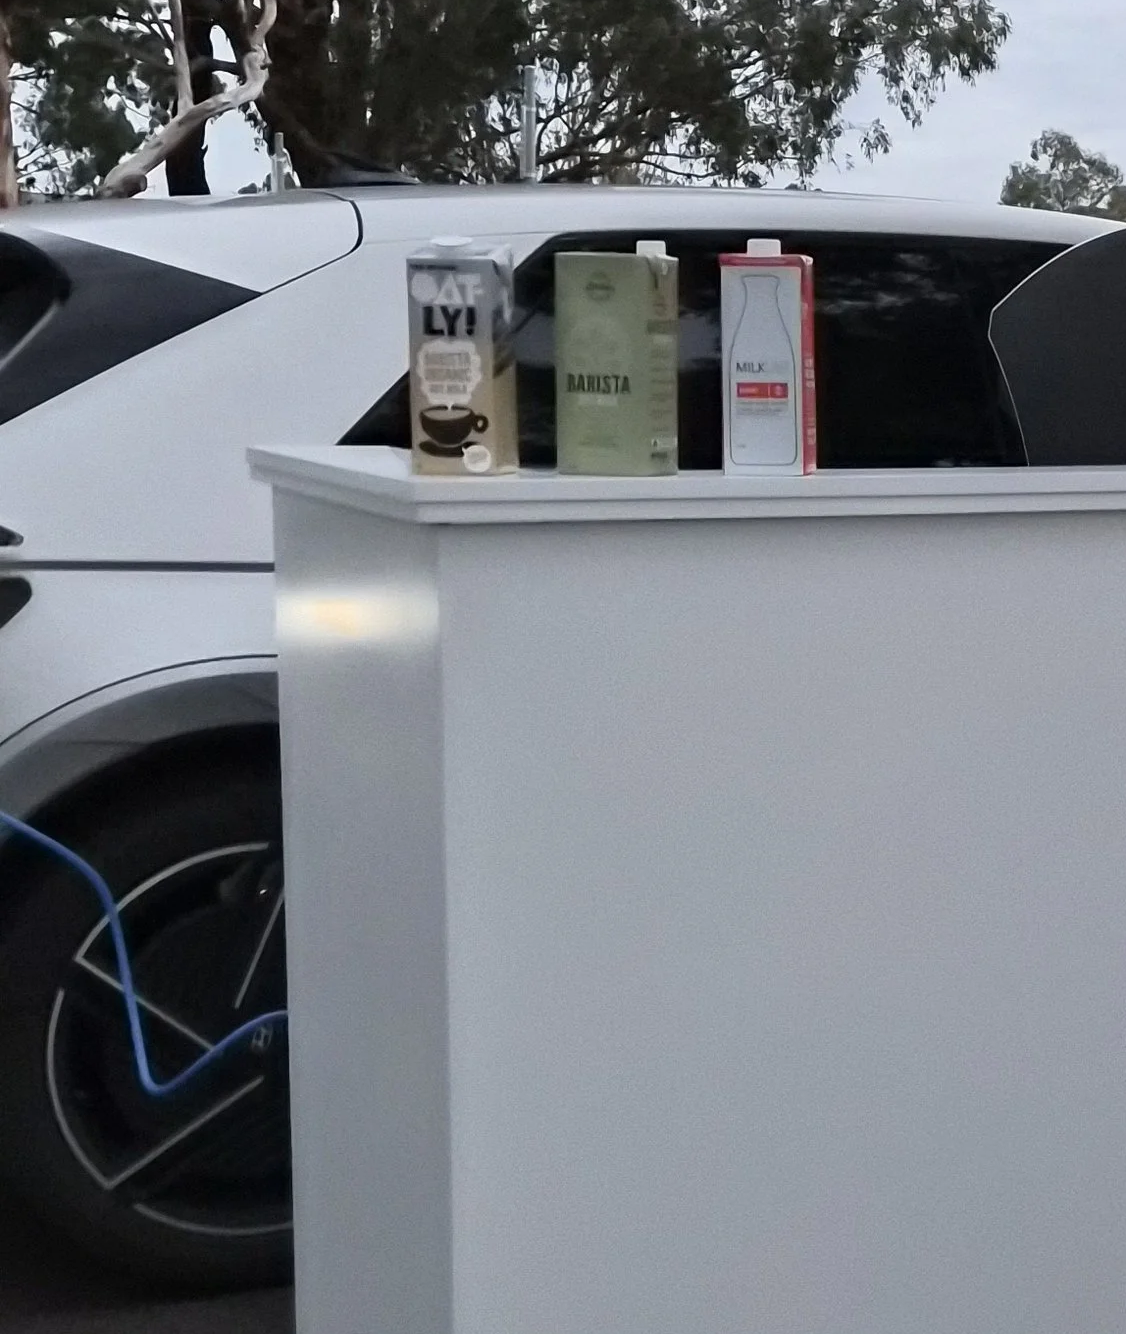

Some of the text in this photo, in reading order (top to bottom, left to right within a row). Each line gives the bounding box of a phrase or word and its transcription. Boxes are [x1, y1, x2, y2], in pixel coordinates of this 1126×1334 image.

[422, 305, 476, 336] LY!
[736, 362, 765, 375] MILK
[567, 373, 631, 395] BARISTA
